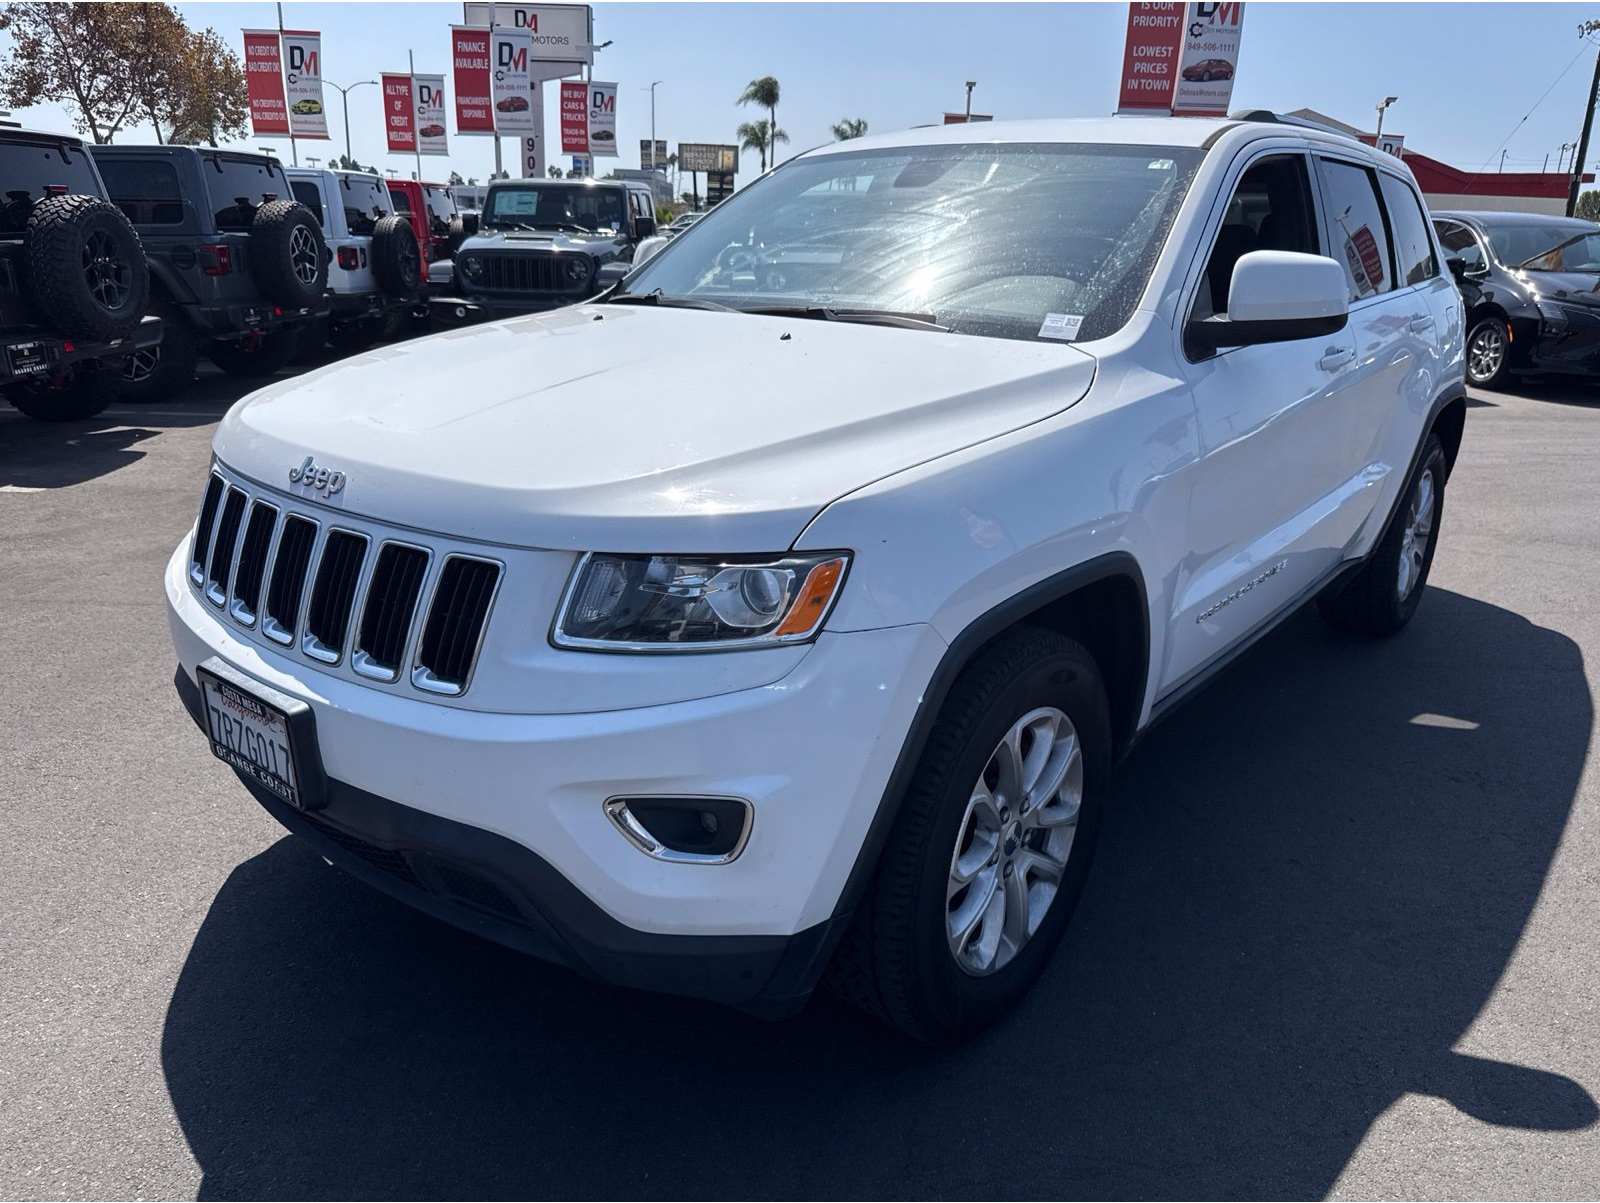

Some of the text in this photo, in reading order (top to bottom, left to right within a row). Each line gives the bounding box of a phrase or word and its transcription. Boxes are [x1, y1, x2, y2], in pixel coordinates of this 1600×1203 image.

[1141, 2, 1175, 11] IS OUR
[1132, 15, 1180, 28] PRIORITY
[457, 41, 486, 53] FINANCE
[532, 36, 569, 46] MOTORS
[498, 42, 527, 73] DM
[1132, 46, 1174, 57] LOWEST
[289, 46, 318, 76] DM
[455, 58, 489, 70] AVAILABLE
[1133, 62, 1168, 74] PRICES
[386, 84, 409, 96] ALL TYPE
[1127, 78, 1170, 91] IN TOWN
[419, 85, 442, 108] DM
[562, 90, 586, 98] WE BUY
[394, 101, 402, 112] OF
[563, 101, 579, 110] CARS
[593, 91, 614, 113] DM
[390, 116, 409, 127] CREDIT
[562, 113, 586, 122] TRUCKS
[389, 131, 414, 143] WELCOME
[289, 456, 346, 498] Jeep
